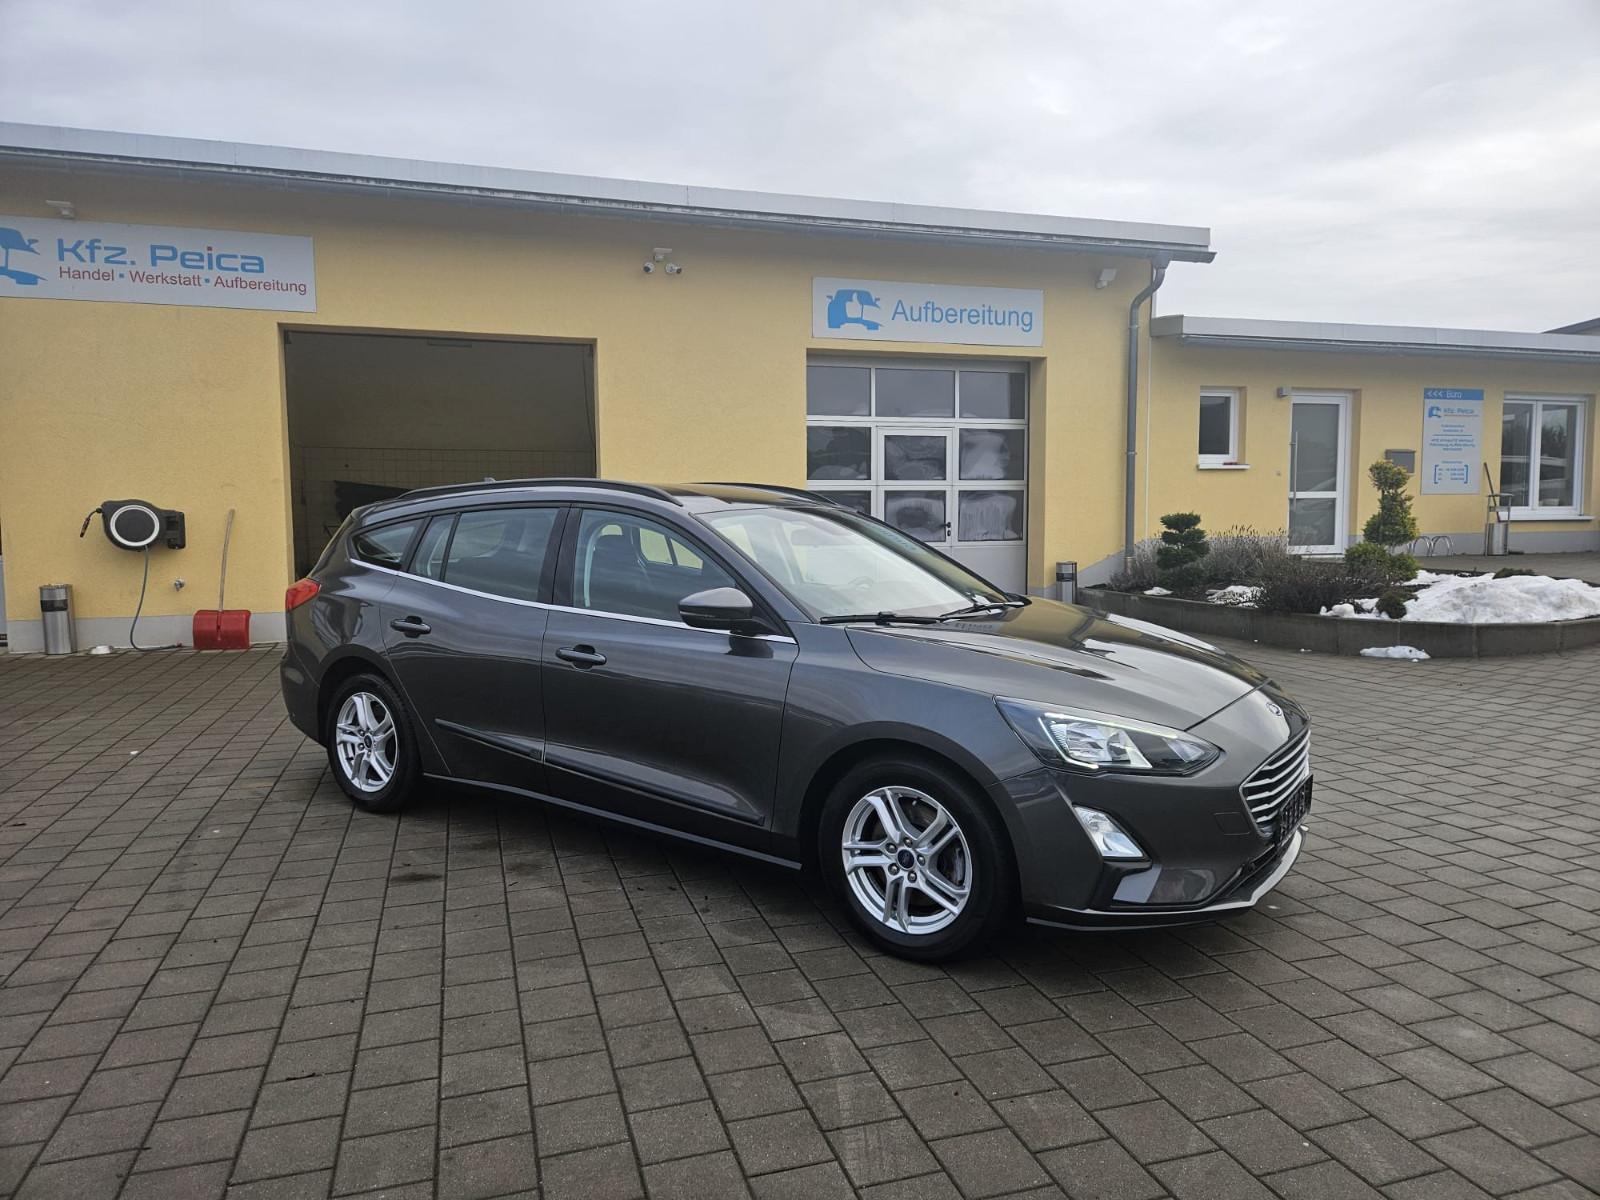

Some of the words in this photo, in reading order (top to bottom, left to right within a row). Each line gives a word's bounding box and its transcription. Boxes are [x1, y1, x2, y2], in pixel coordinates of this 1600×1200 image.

[56, 238, 136, 265] Kfz.
[150, 245, 265, 274] Peica
[59, 266, 115, 282] Handel
[128, 271, 202, 288] Werkstatt
[214, 275, 308, 296] Aufbereitung
[891, 299, 1033, 333] Aufbereitung
